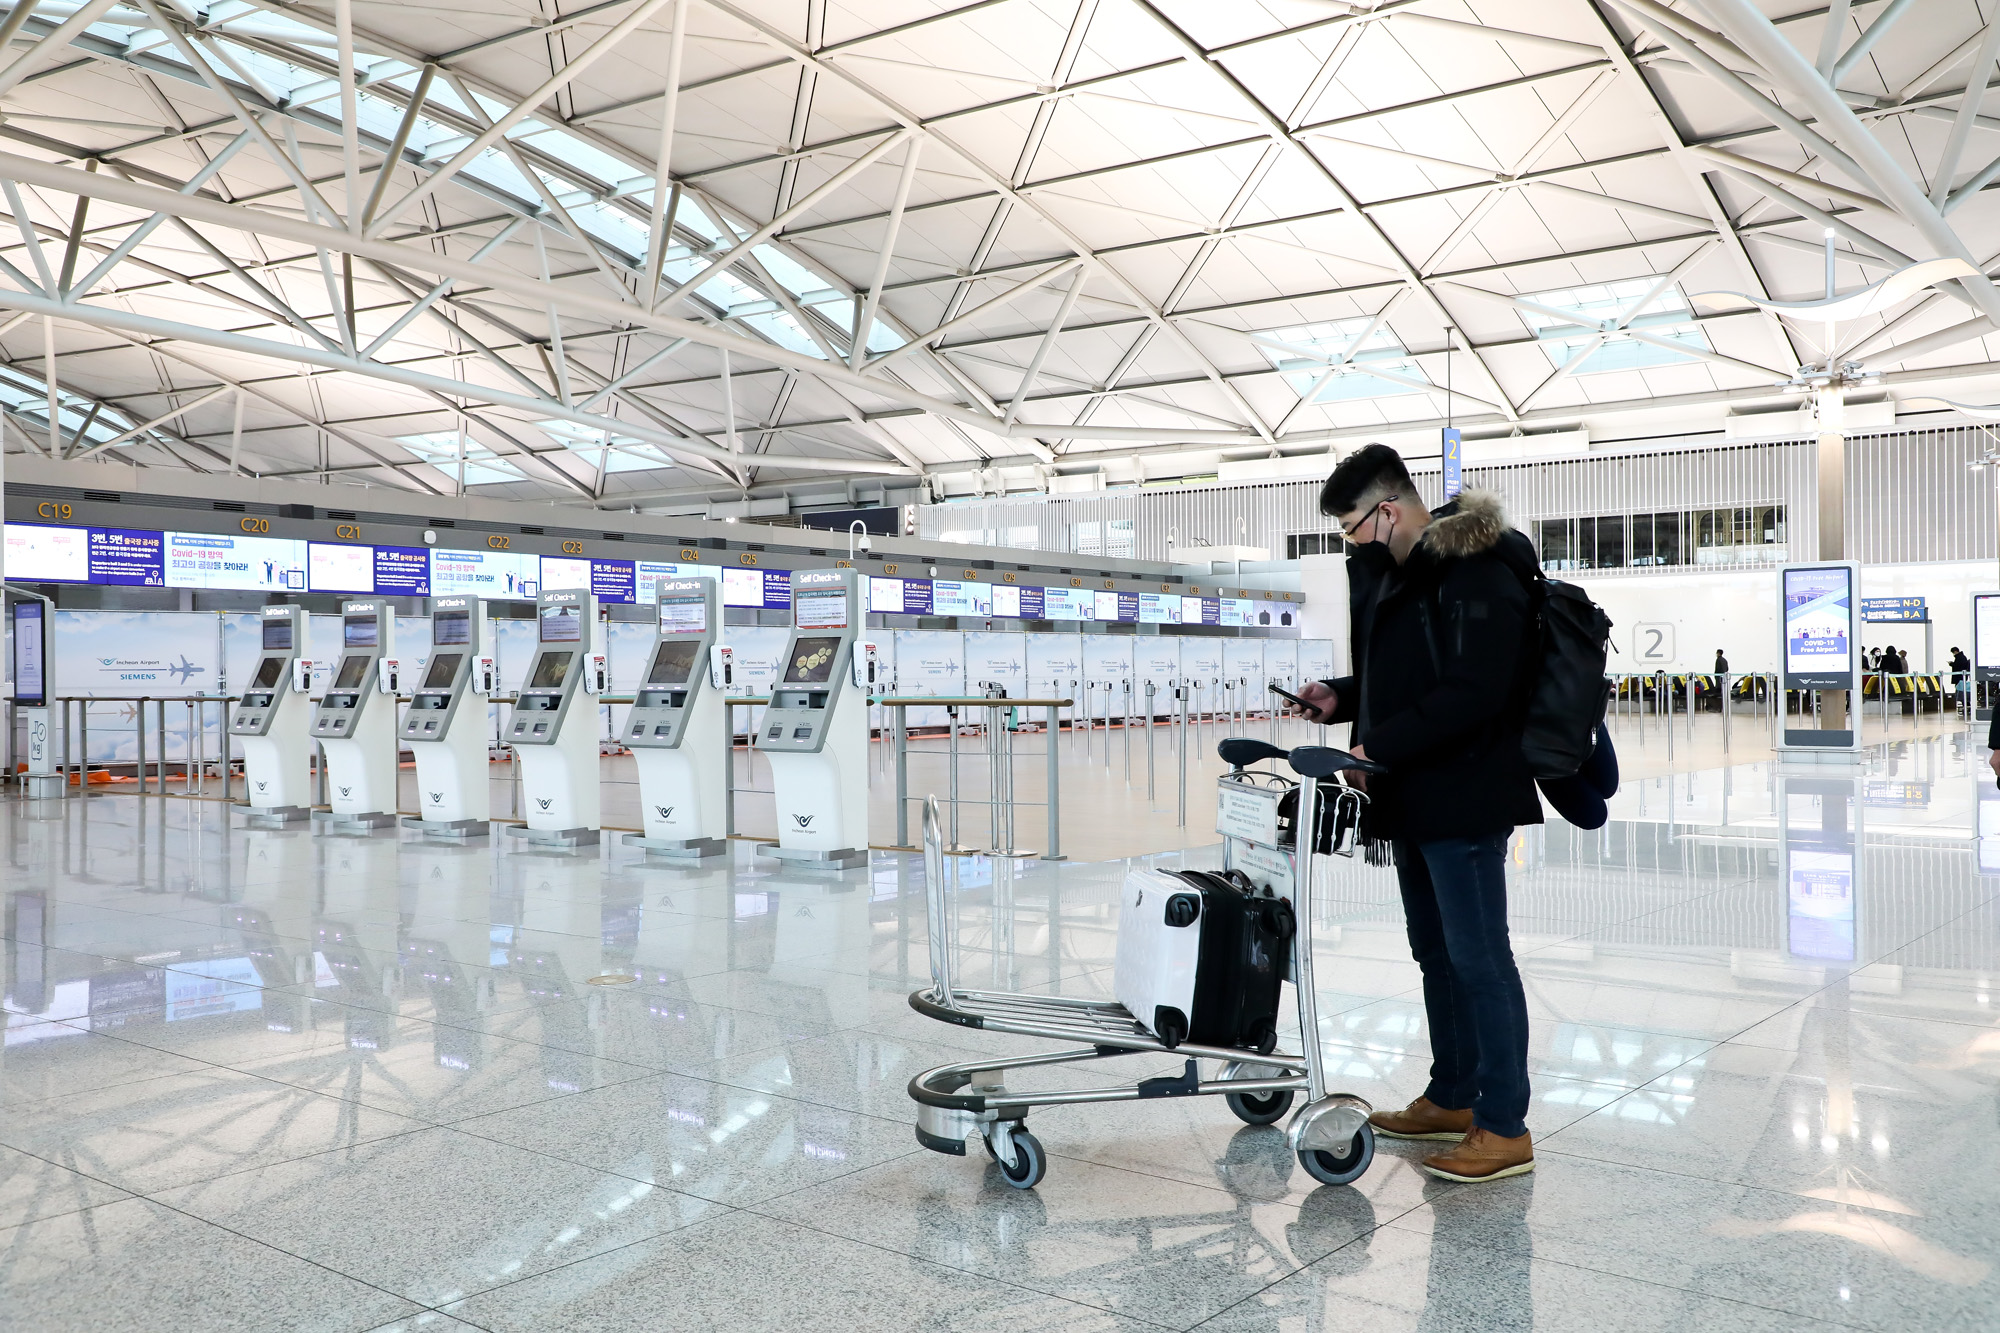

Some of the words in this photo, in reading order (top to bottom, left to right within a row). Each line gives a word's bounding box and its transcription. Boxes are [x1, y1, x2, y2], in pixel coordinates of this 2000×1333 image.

[1448, 440, 1457, 459] 2
[38, 502, 72, 519] C19
[241, 518, 269, 532] C20
[336, 525, 360, 539] C21
[92, 534, 107, 543] 3번,
[109, 535, 123, 544] 5번
[488, 536, 510, 549] C22
[563, 541, 583, 553] C23
[172, 549, 205, 558] Covid-19
[208, 551, 223, 559] 방역
[681, 550, 699, 561] C24
[740, 554, 757, 564] C25
[172, 560, 195, 568] 최고의
[198, 560, 221, 570] 공항을
[224, 562, 248, 571] 찾아라!
[436, 563, 461, 571] Covid-19
[885, 564, 898, 574] C27
[800, 574, 812, 583] Self
[812, 573, 841, 583] Check-in
[964, 570, 976, 579] C28
[1003, 573, 1016, 582] C29
[664, 582, 674, 590] Self
[676, 581, 700, 590] Check-in
[1070, 578, 1081, 587] C30
[1904, 610, 1920, 619] B,A
[1645, 629, 1663, 658] 2
[33, 742, 41, 754] kg
